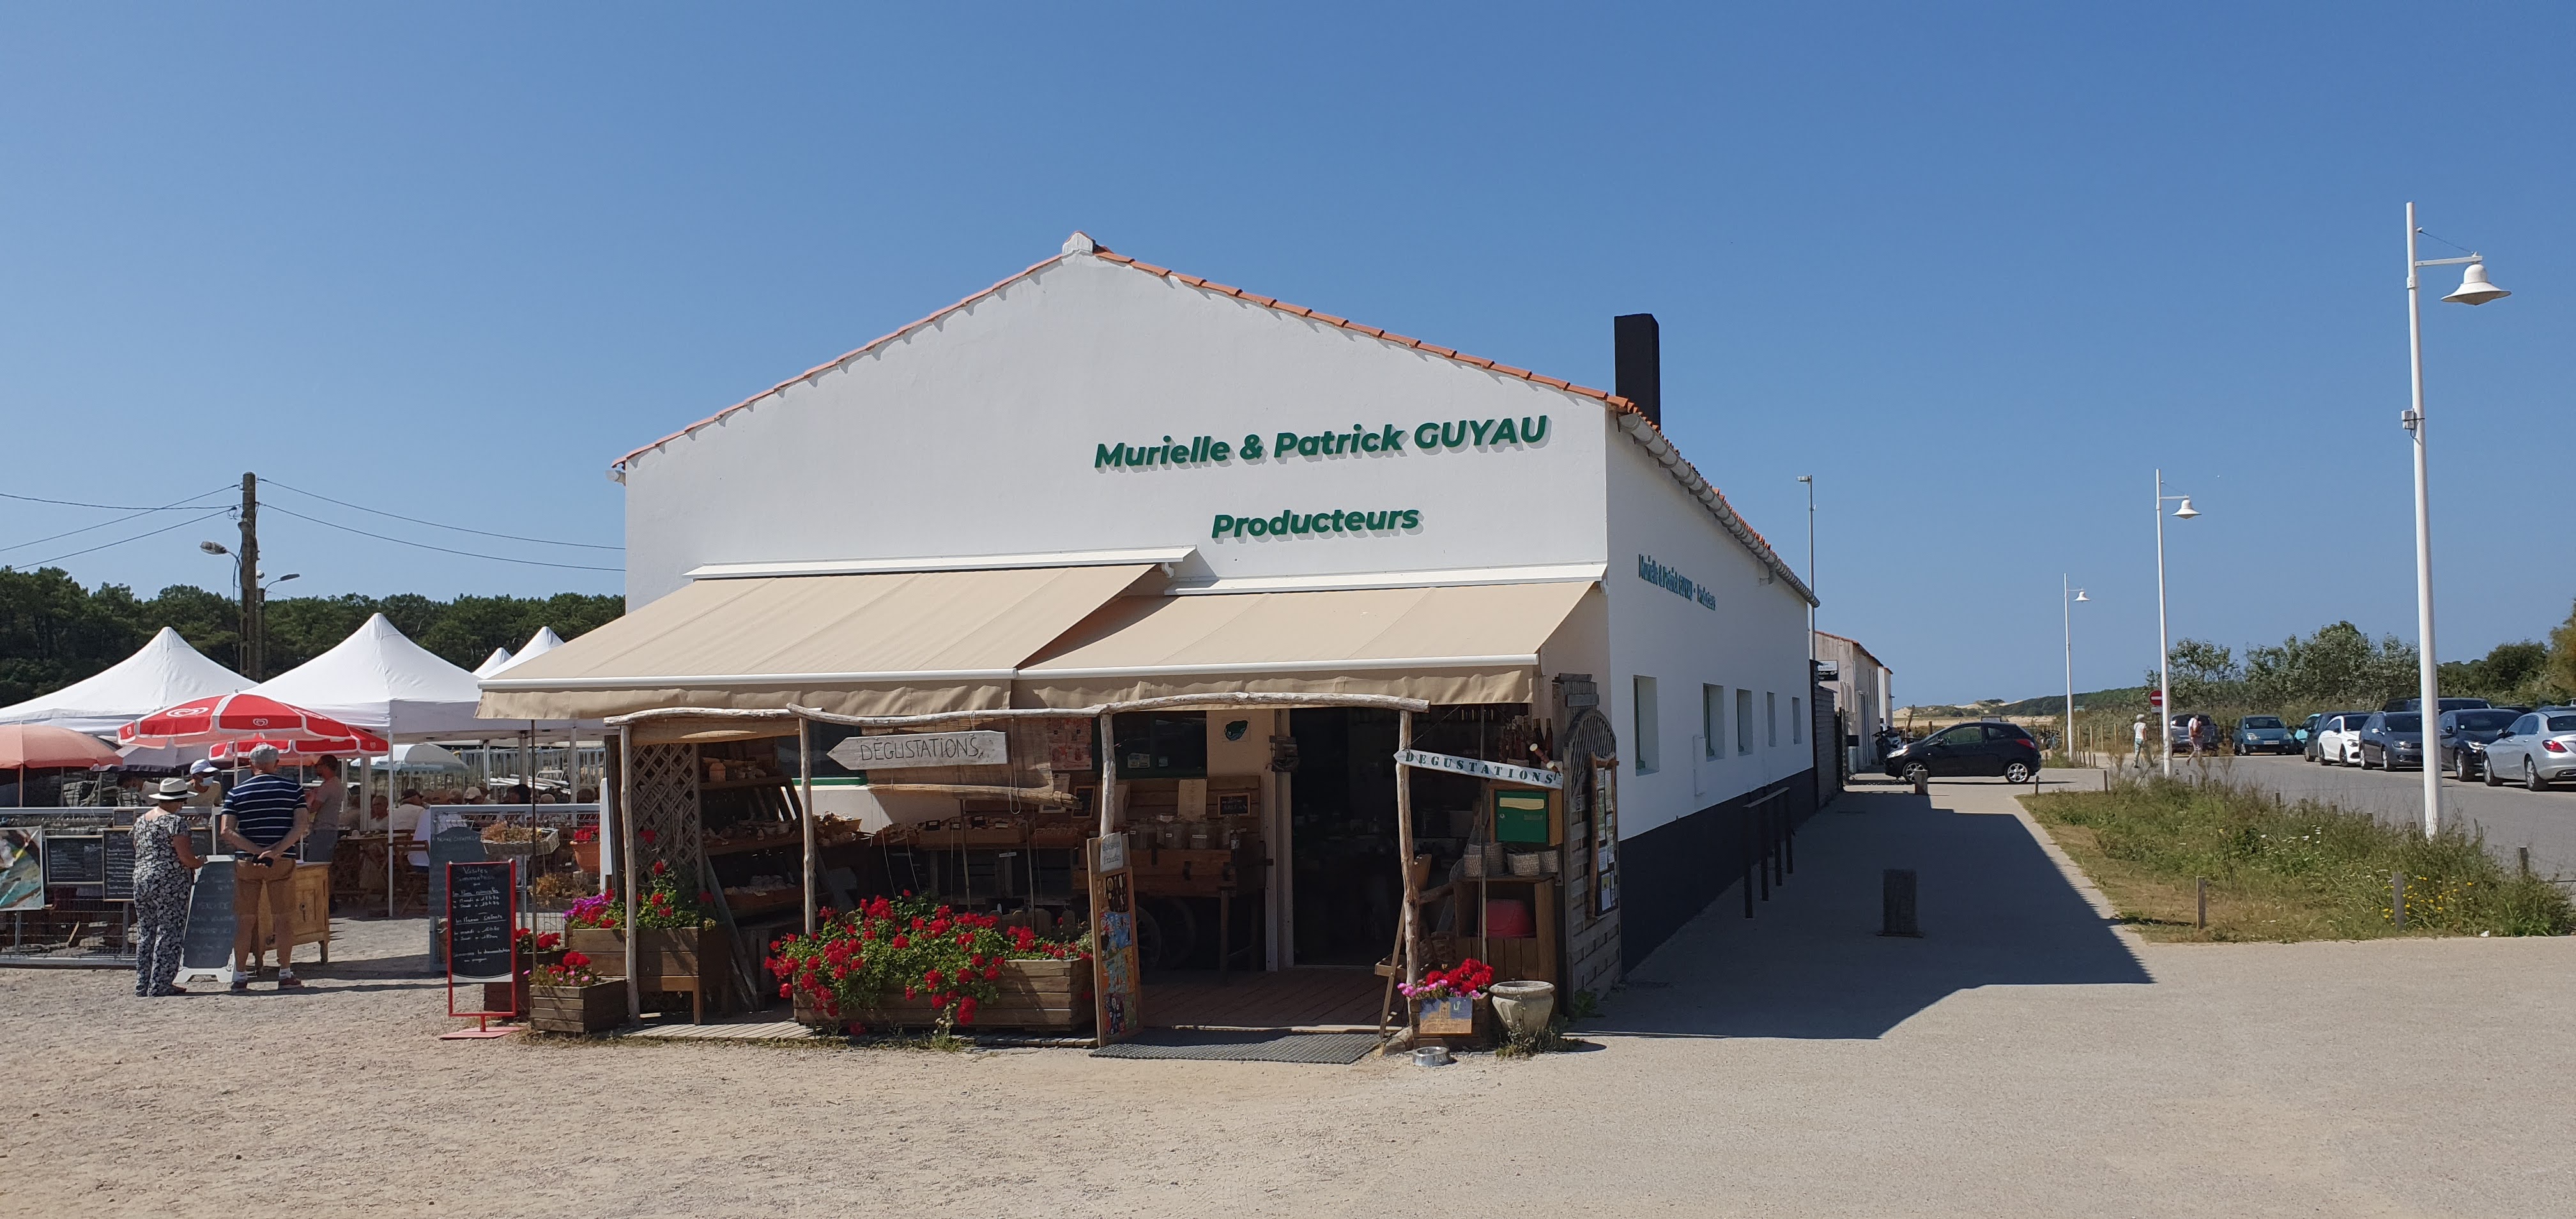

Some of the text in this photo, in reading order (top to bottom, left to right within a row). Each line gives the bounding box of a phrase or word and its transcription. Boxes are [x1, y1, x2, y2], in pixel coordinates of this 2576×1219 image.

[1094, 415, 1548, 468] Murielle & Patrick GUYAU
[1211, 508, 1420, 539] Producteurs
[1405, 752, 1553, 785] DEGUSTATIONS
